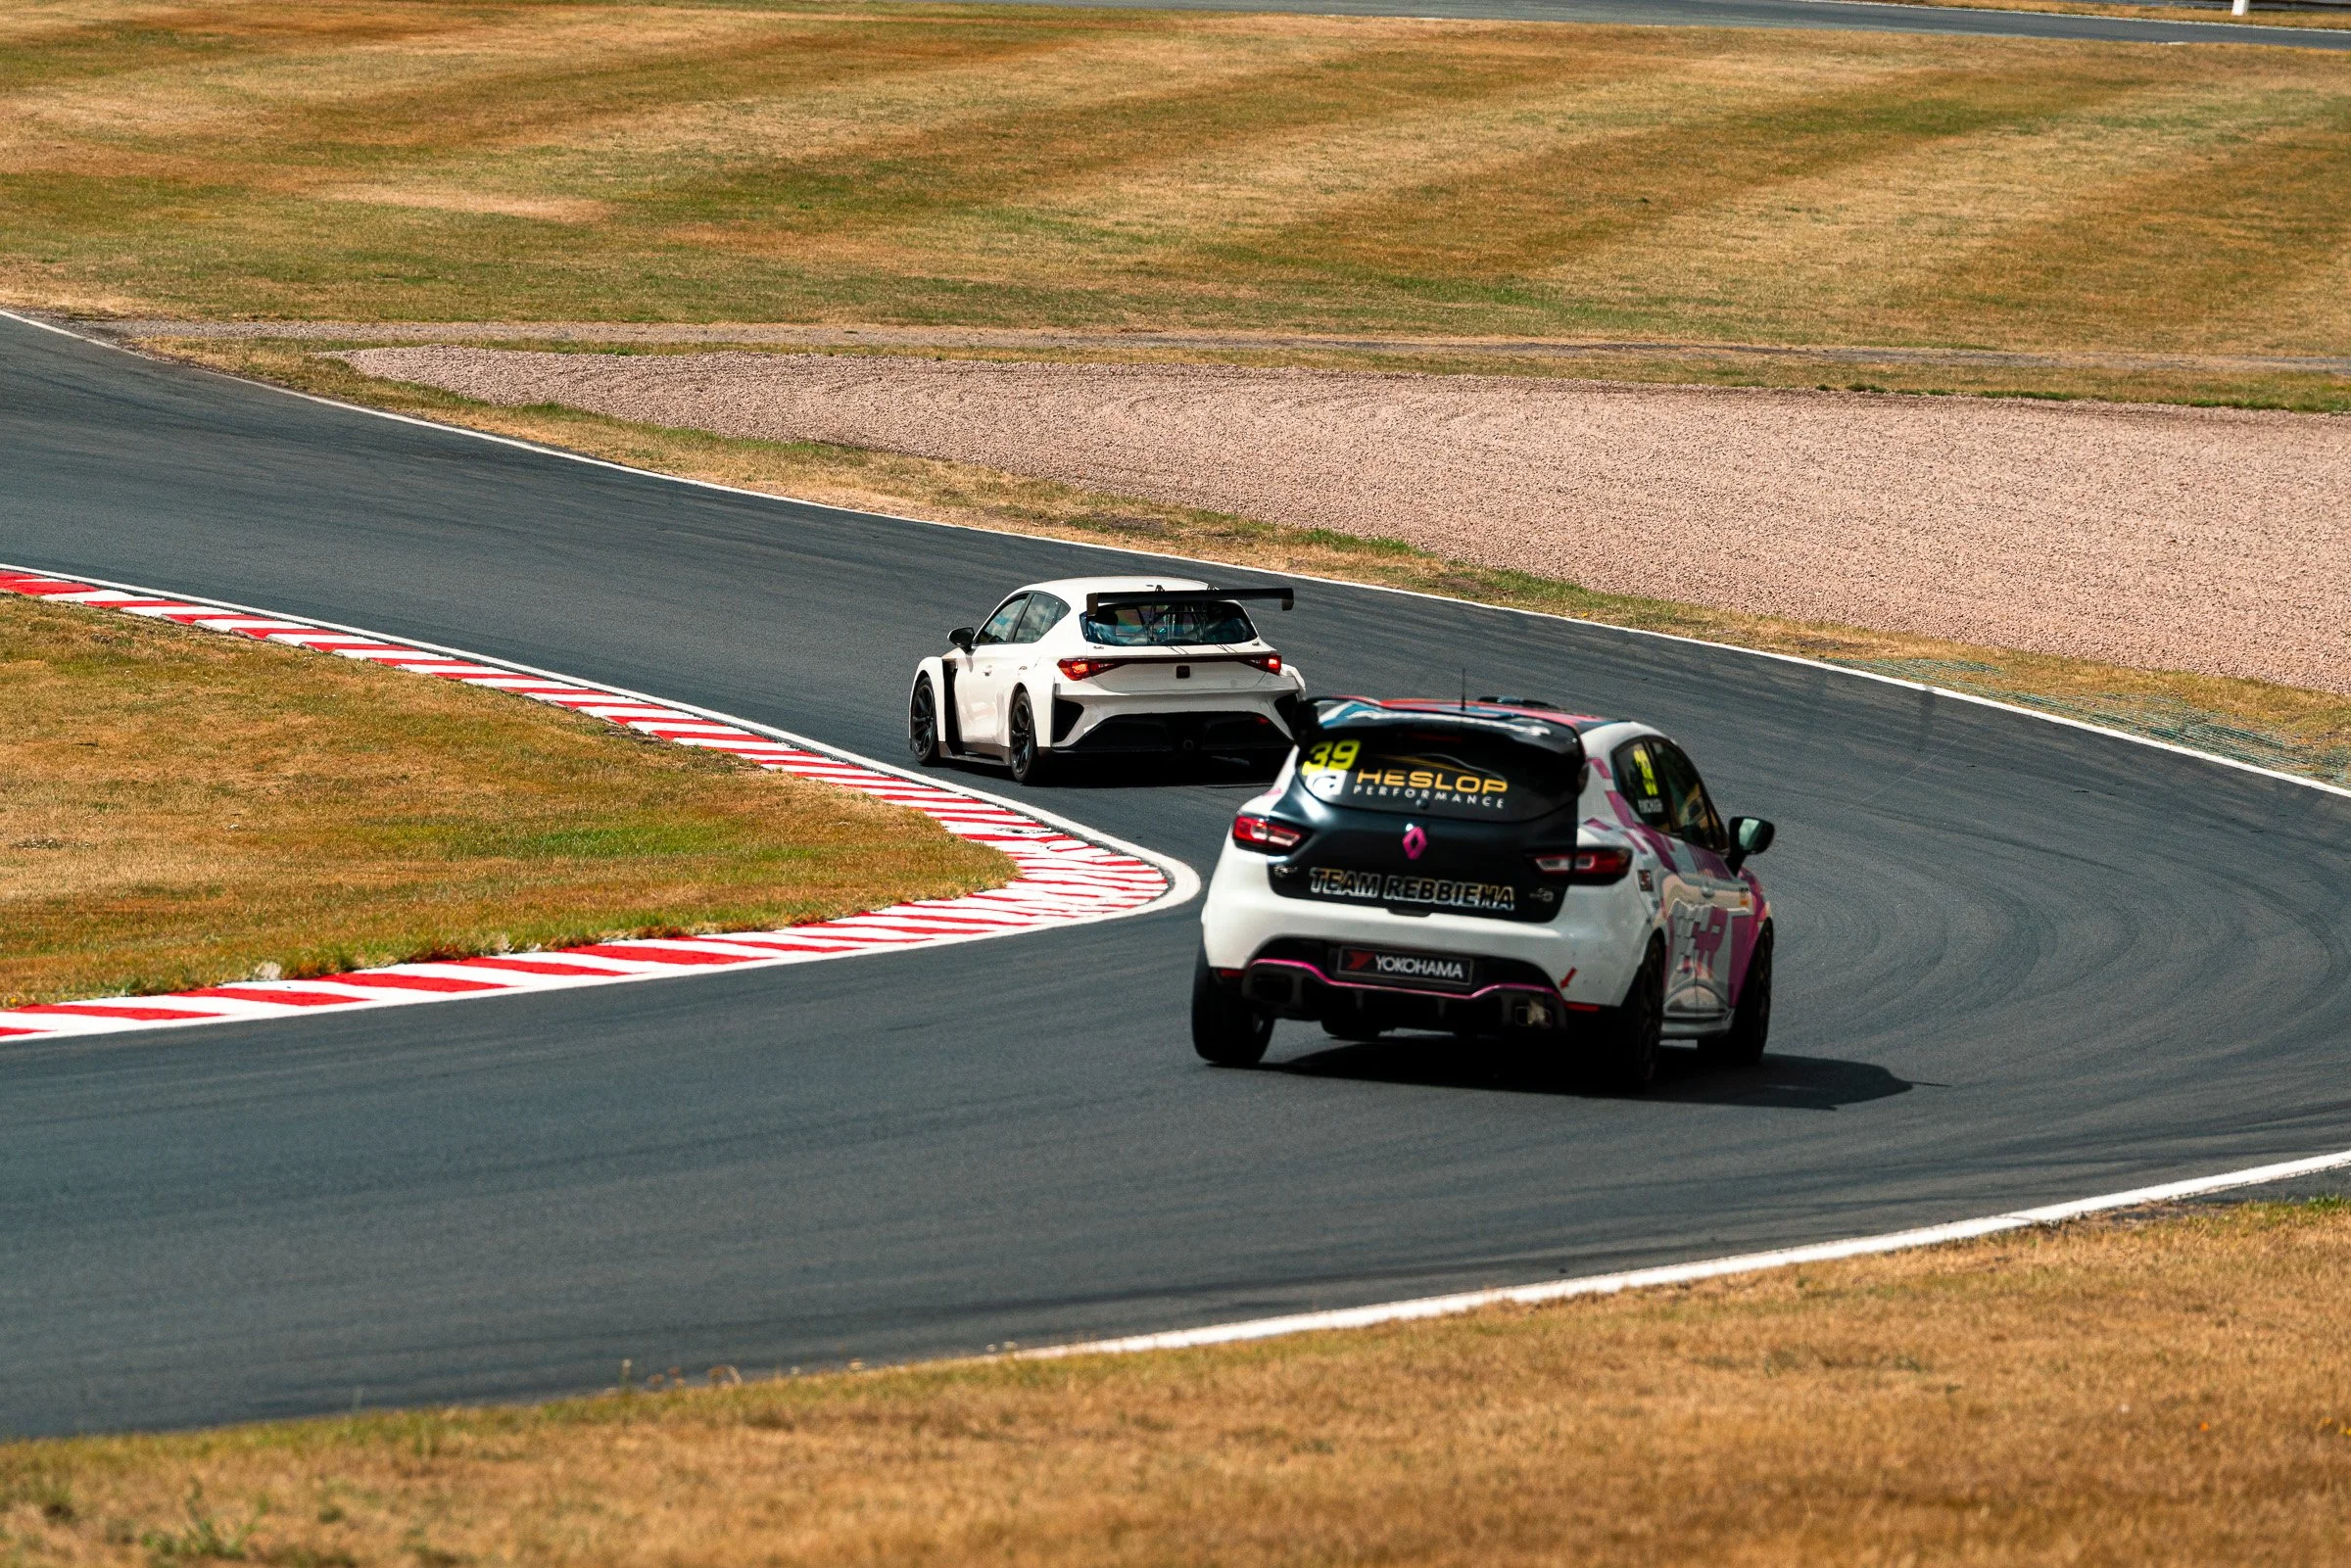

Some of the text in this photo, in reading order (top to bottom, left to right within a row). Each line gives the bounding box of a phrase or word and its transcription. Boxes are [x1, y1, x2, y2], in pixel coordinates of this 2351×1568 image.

[1301, 739, 1361, 778] 39
[1357, 769, 1509, 794] HESLOP
[1353, 784, 1505, 809] PERFORMANCE
[1309, 867, 1379, 898] TEAM
[1374, 955, 1463, 978] YOKOHAMA
